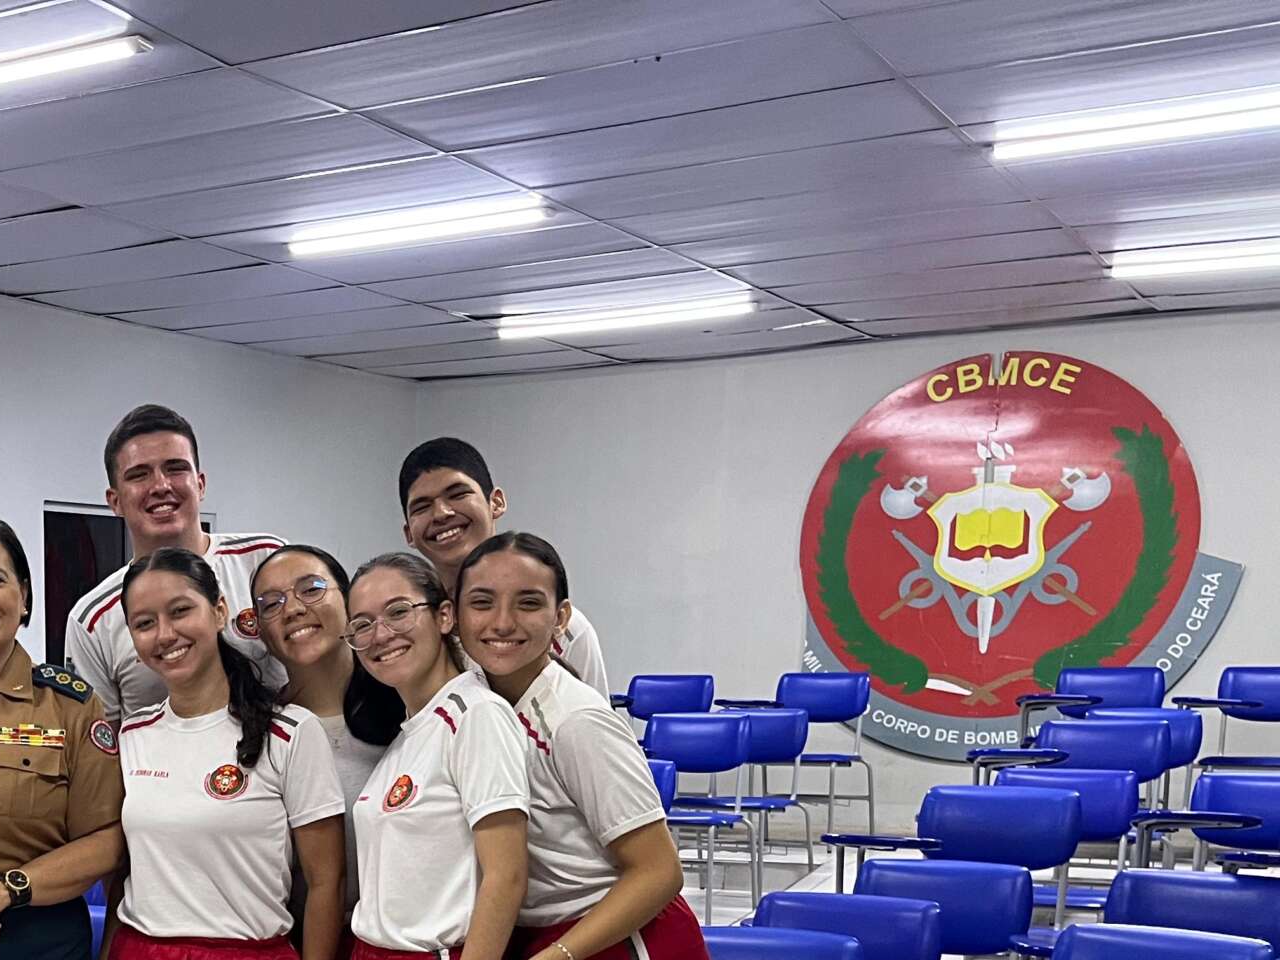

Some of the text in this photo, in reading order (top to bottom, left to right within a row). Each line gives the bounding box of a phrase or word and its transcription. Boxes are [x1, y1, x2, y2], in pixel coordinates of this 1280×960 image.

[926, 357, 1082, 403] CBMCE
[872, 709, 931, 739] CORPO
[934, 728, 960, 744] DE
[1167, 633, 1192, 658] DO
[1186, 572, 1223, 631] CEARÁ
